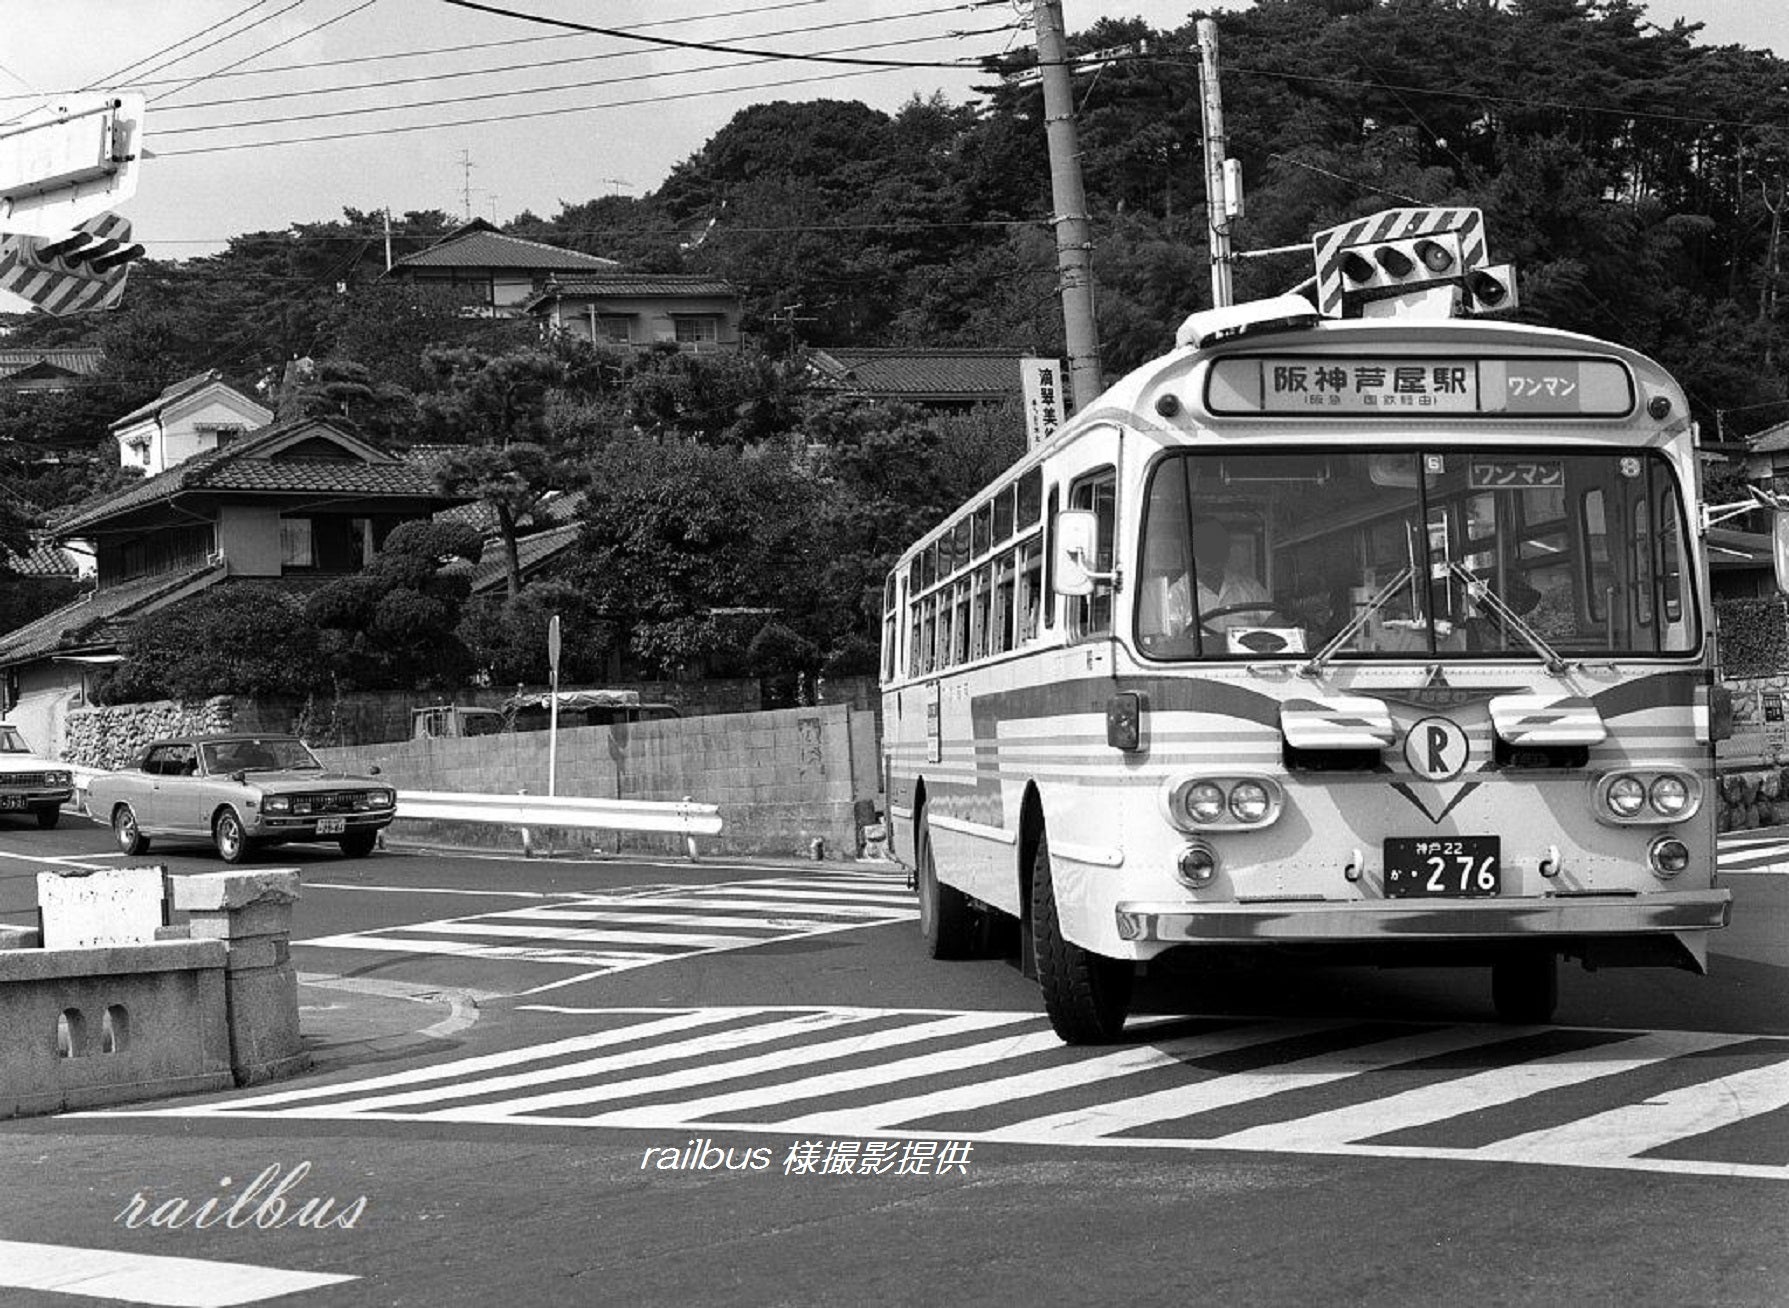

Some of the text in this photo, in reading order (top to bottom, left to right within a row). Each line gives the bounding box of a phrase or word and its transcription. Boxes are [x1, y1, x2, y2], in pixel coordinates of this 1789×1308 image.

[1273, 366, 1467, 394] 阪神芦屋駅
[1508, 377, 1577, 396] ワンマン
[1474, 464, 1560, 485] ワンマン
[1427, 726, 1449, 773] R
